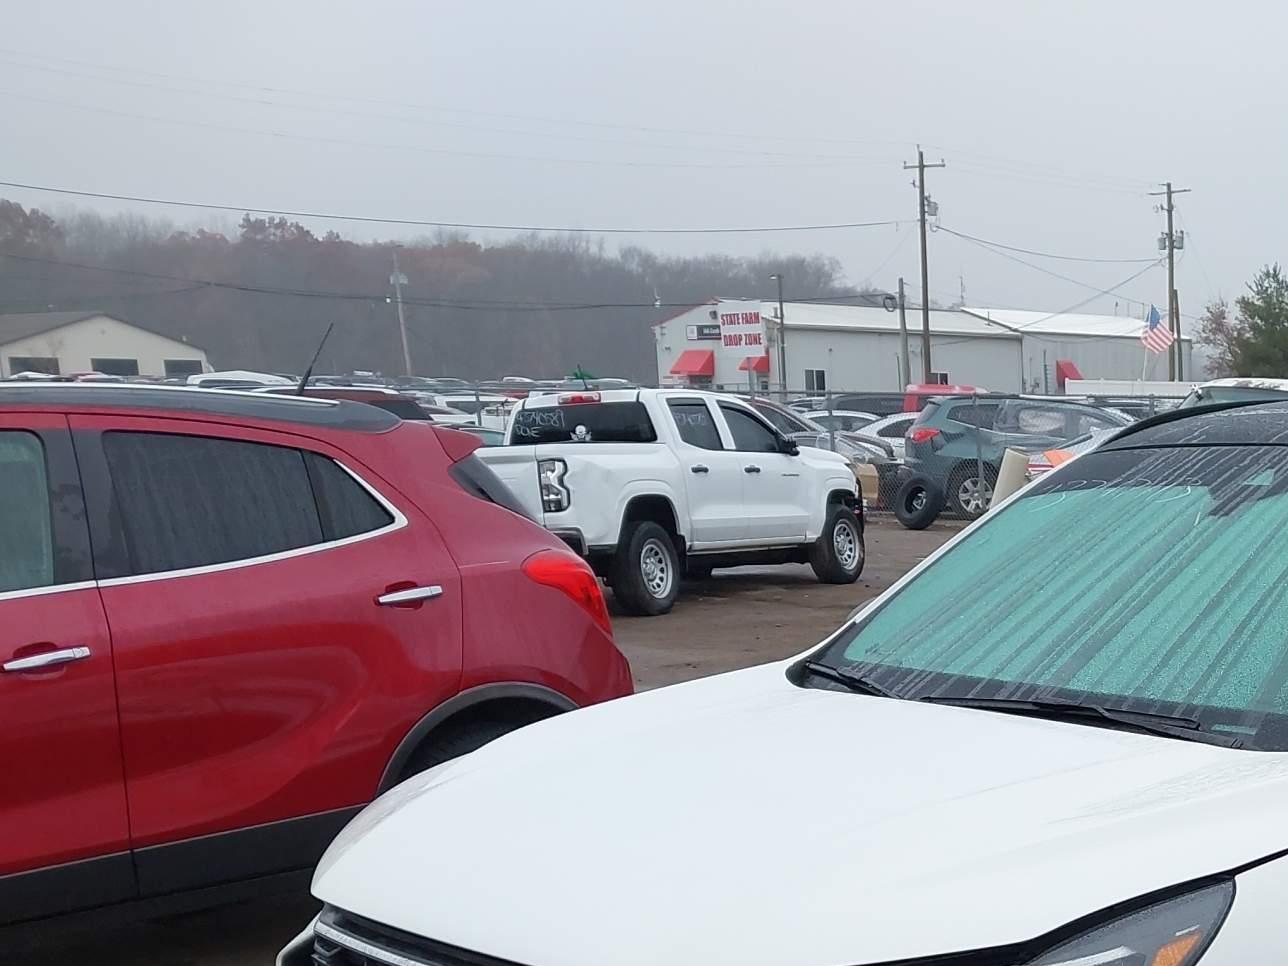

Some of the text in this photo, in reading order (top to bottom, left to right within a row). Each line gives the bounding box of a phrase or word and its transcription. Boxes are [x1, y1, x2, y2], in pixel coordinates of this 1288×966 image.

[721, 312, 760, 326] STATE FARM
[723, 333, 762, 346] DROP ZONE
